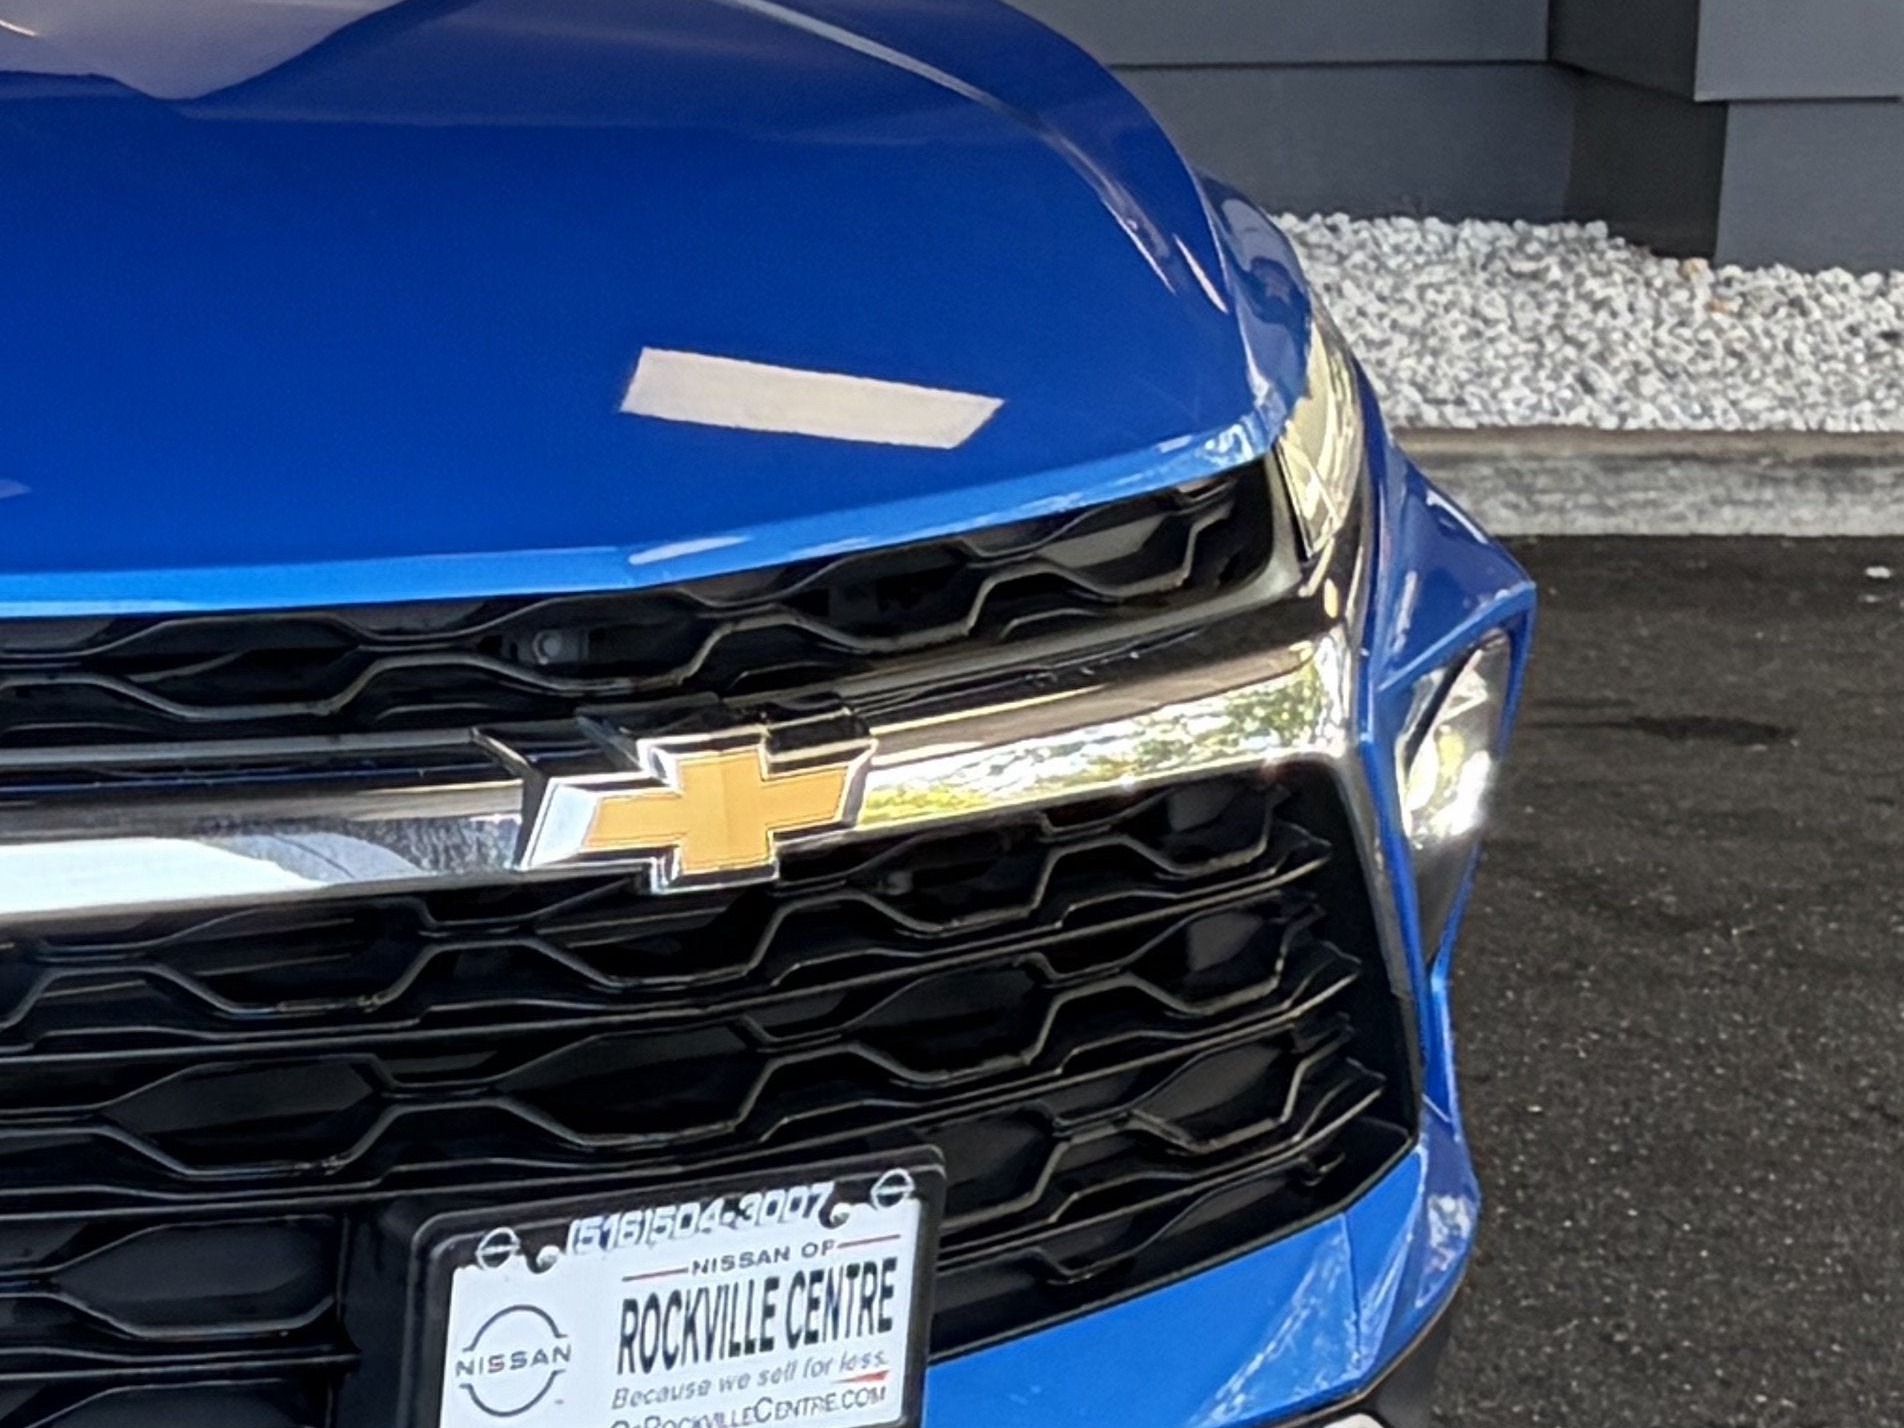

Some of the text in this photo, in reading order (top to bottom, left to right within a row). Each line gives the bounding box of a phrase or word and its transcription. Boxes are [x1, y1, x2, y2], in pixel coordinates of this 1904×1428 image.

[693, 1239, 835, 1274] NISSAN OF
[617, 1257, 897, 1374] ROCKVILLE CENTRE
[455, 1344, 571, 1376] NISSAN
[611, 1379, 712, 1410] Because
[719, 1375, 751, 1394] we
[757, 1360, 798, 1387] sell
[803, 1354, 833, 1380] for
